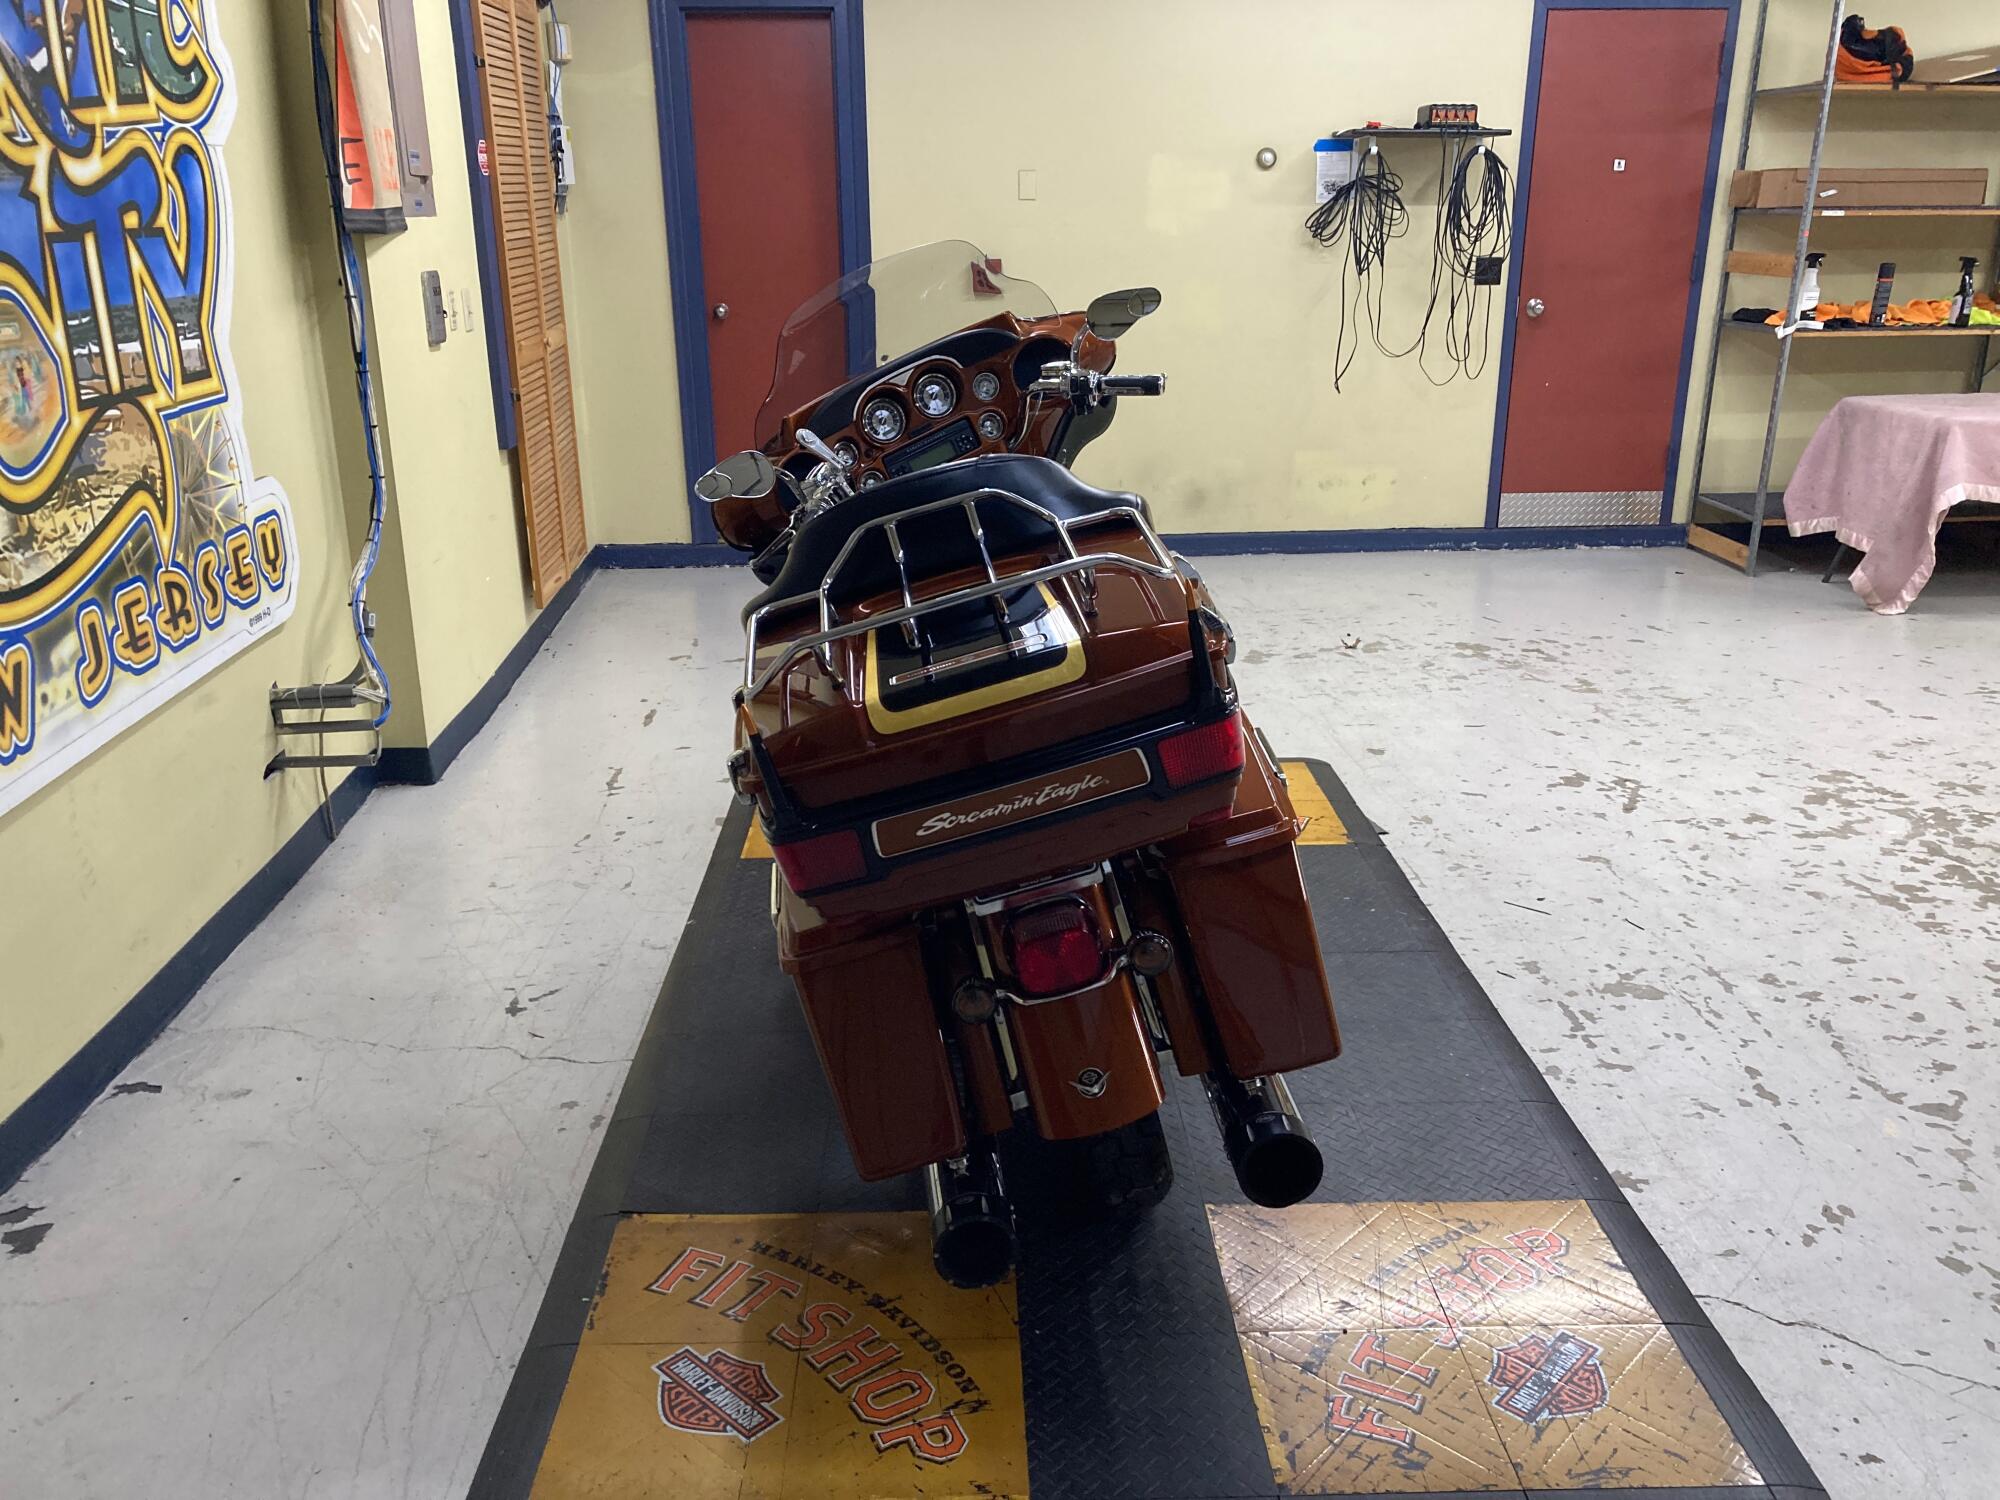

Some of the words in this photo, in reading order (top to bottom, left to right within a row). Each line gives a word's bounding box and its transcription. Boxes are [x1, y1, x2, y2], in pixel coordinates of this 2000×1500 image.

[77, 515, 285, 702] JERSEY
[1036, 774, 1105, 806] Eagle
[647, 1246, 801, 1322] FIT
[770, 1303, 970, 1463] SHOP
[669, 1357, 765, 1430] HARLEY-DAVIDSON
[1328, 1333, 1438, 1449] FIT
